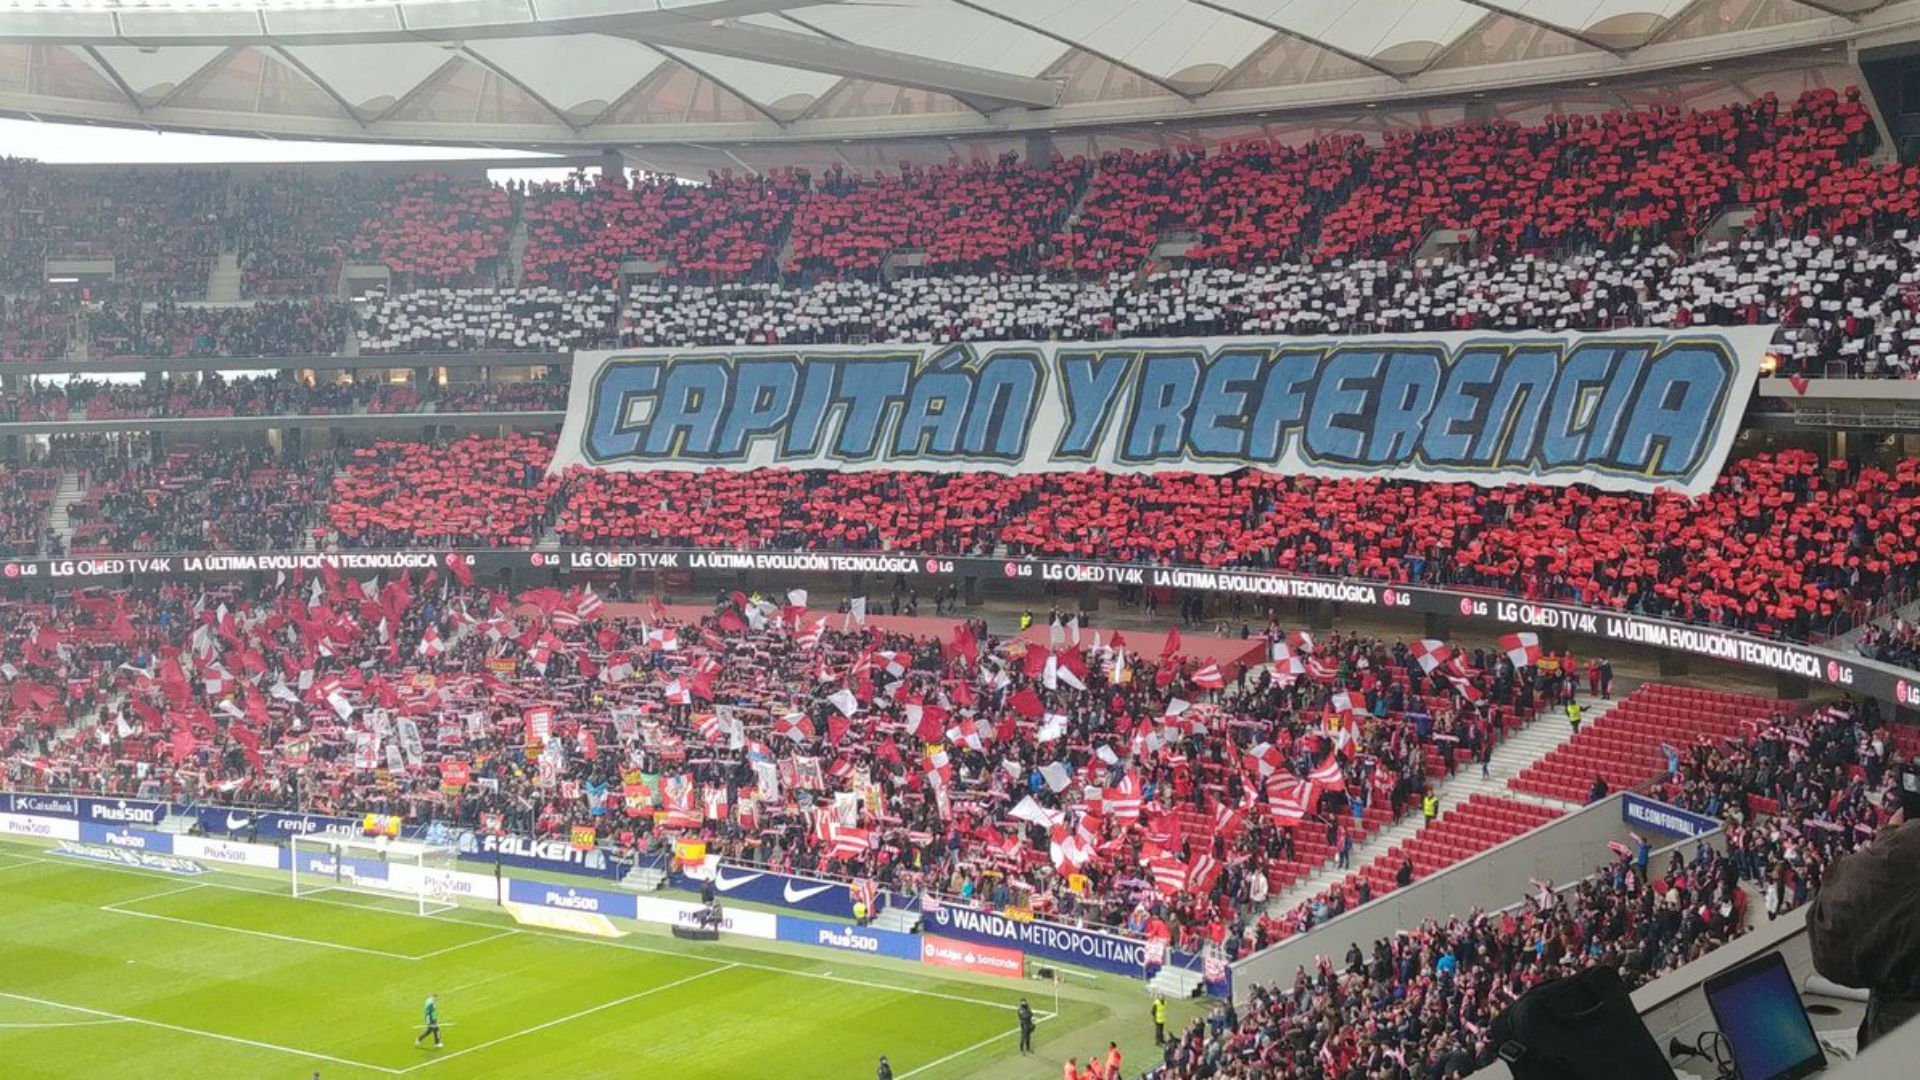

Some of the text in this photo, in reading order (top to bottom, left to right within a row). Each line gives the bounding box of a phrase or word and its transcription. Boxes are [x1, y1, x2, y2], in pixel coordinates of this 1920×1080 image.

[590, 342, 1734, 478] CAPITÁN Y REFERENCIA
[51, 561, 74, 576] LG
[77, 560, 125, 575] OLED
[183, 557, 202, 571] LA
[205, 555, 256, 571] ÚLTIMA
[340, 552, 438, 568] TECNOLÓGICA
[545, 554, 560, 565] LG
[571, 553, 592, 568] LG
[595, 553, 636, 568] OLED
[689, 552, 919, 573] LA ÚLTIMA EVOLUCIÓN TECNOLÓGICA
[939, 561, 954, 573] LG
[1018, 565, 1032, 576] LG
[1043, 564, 1062, 579] LG
[1065, 565, 1104, 582] OLED
[1154, 569, 1376, 603] LA ÚLTIMA EVOLUCIÓN TECNOLÓGICA
[1396, 593, 1410, 606] LG
[1473, 602, 1488, 615] LG
[1498, 603, 1517, 622] LG
[1520, 605, 1559, 626] OLED
[1607, 618, 1822, 678] LA ÚLTIMA EVOLUCIÓN TECNOLÓGICA
[1839, 666, 1853, 684] LG
[28, 798, 73, 812] CaixaBank
[92, 803, 154, 823] Plus500
[9, 820, 50, 834] Plus500
[277, 816, 317, 836] renfe
[105, 831, 145, 848] Plus500
[203, 846, 245, 861] Plus500
[546, 890, 598, 911] Plus500
[819, 929, 878, 951] Plus500
[953, 908, 1018, 940] WANDA
[1020, 924, 1146, 967] METROPOLITANO
[977, 953, 1020, 970] Santander
